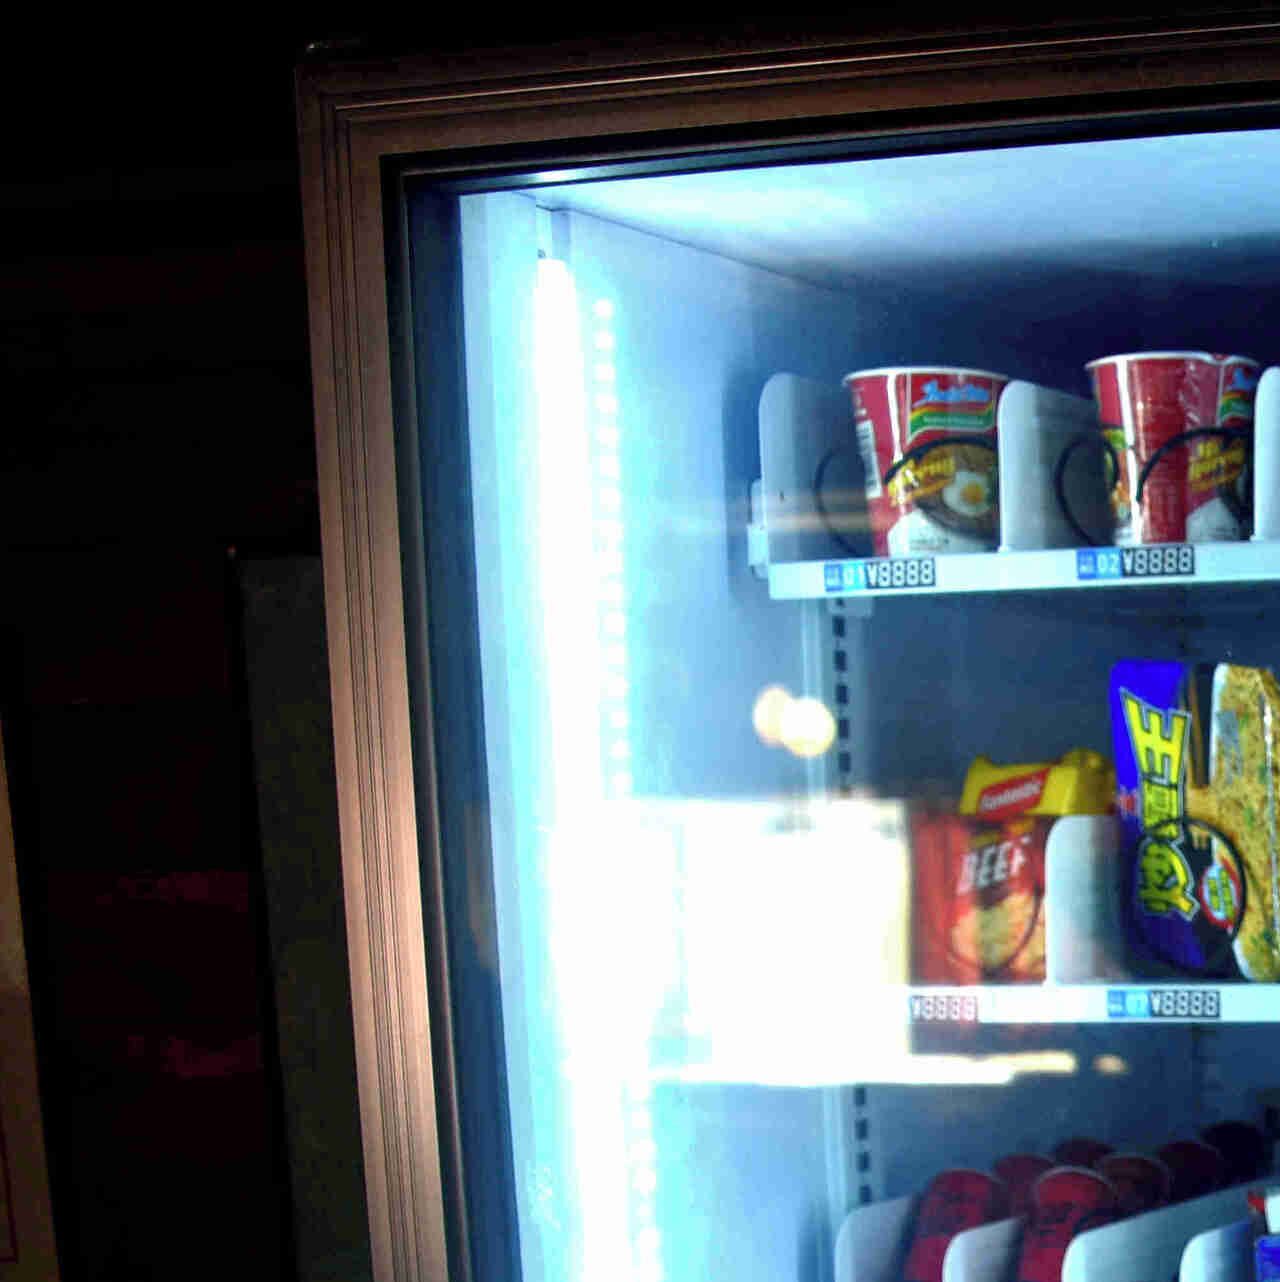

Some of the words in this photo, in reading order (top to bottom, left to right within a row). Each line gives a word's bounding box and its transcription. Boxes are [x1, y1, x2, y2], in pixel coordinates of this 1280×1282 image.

[1122, 547, 1194, 576] ¥8888
[956, 837, 1031, 897] BEEF
[1150, 990, 1221, 1019] ¥8888
